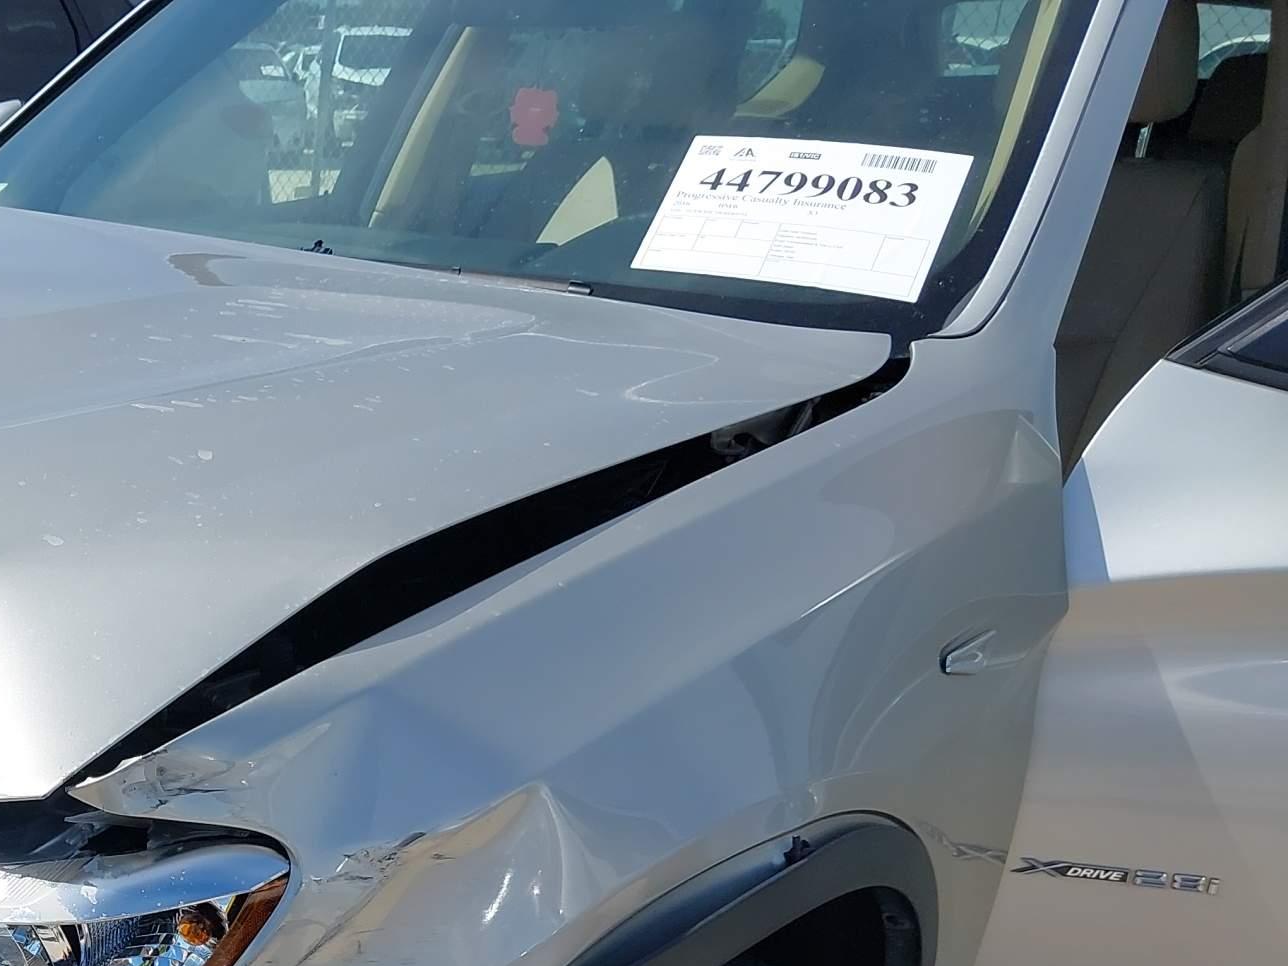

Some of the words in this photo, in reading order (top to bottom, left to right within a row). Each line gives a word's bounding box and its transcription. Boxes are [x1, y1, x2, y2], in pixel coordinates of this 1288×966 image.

[676, 191, 739, 201] Progressive
[742, 193, 790, 205] Casualty
[793, 198, 847, 210] Insurance
[699, 167, 919, 207] 44799083
